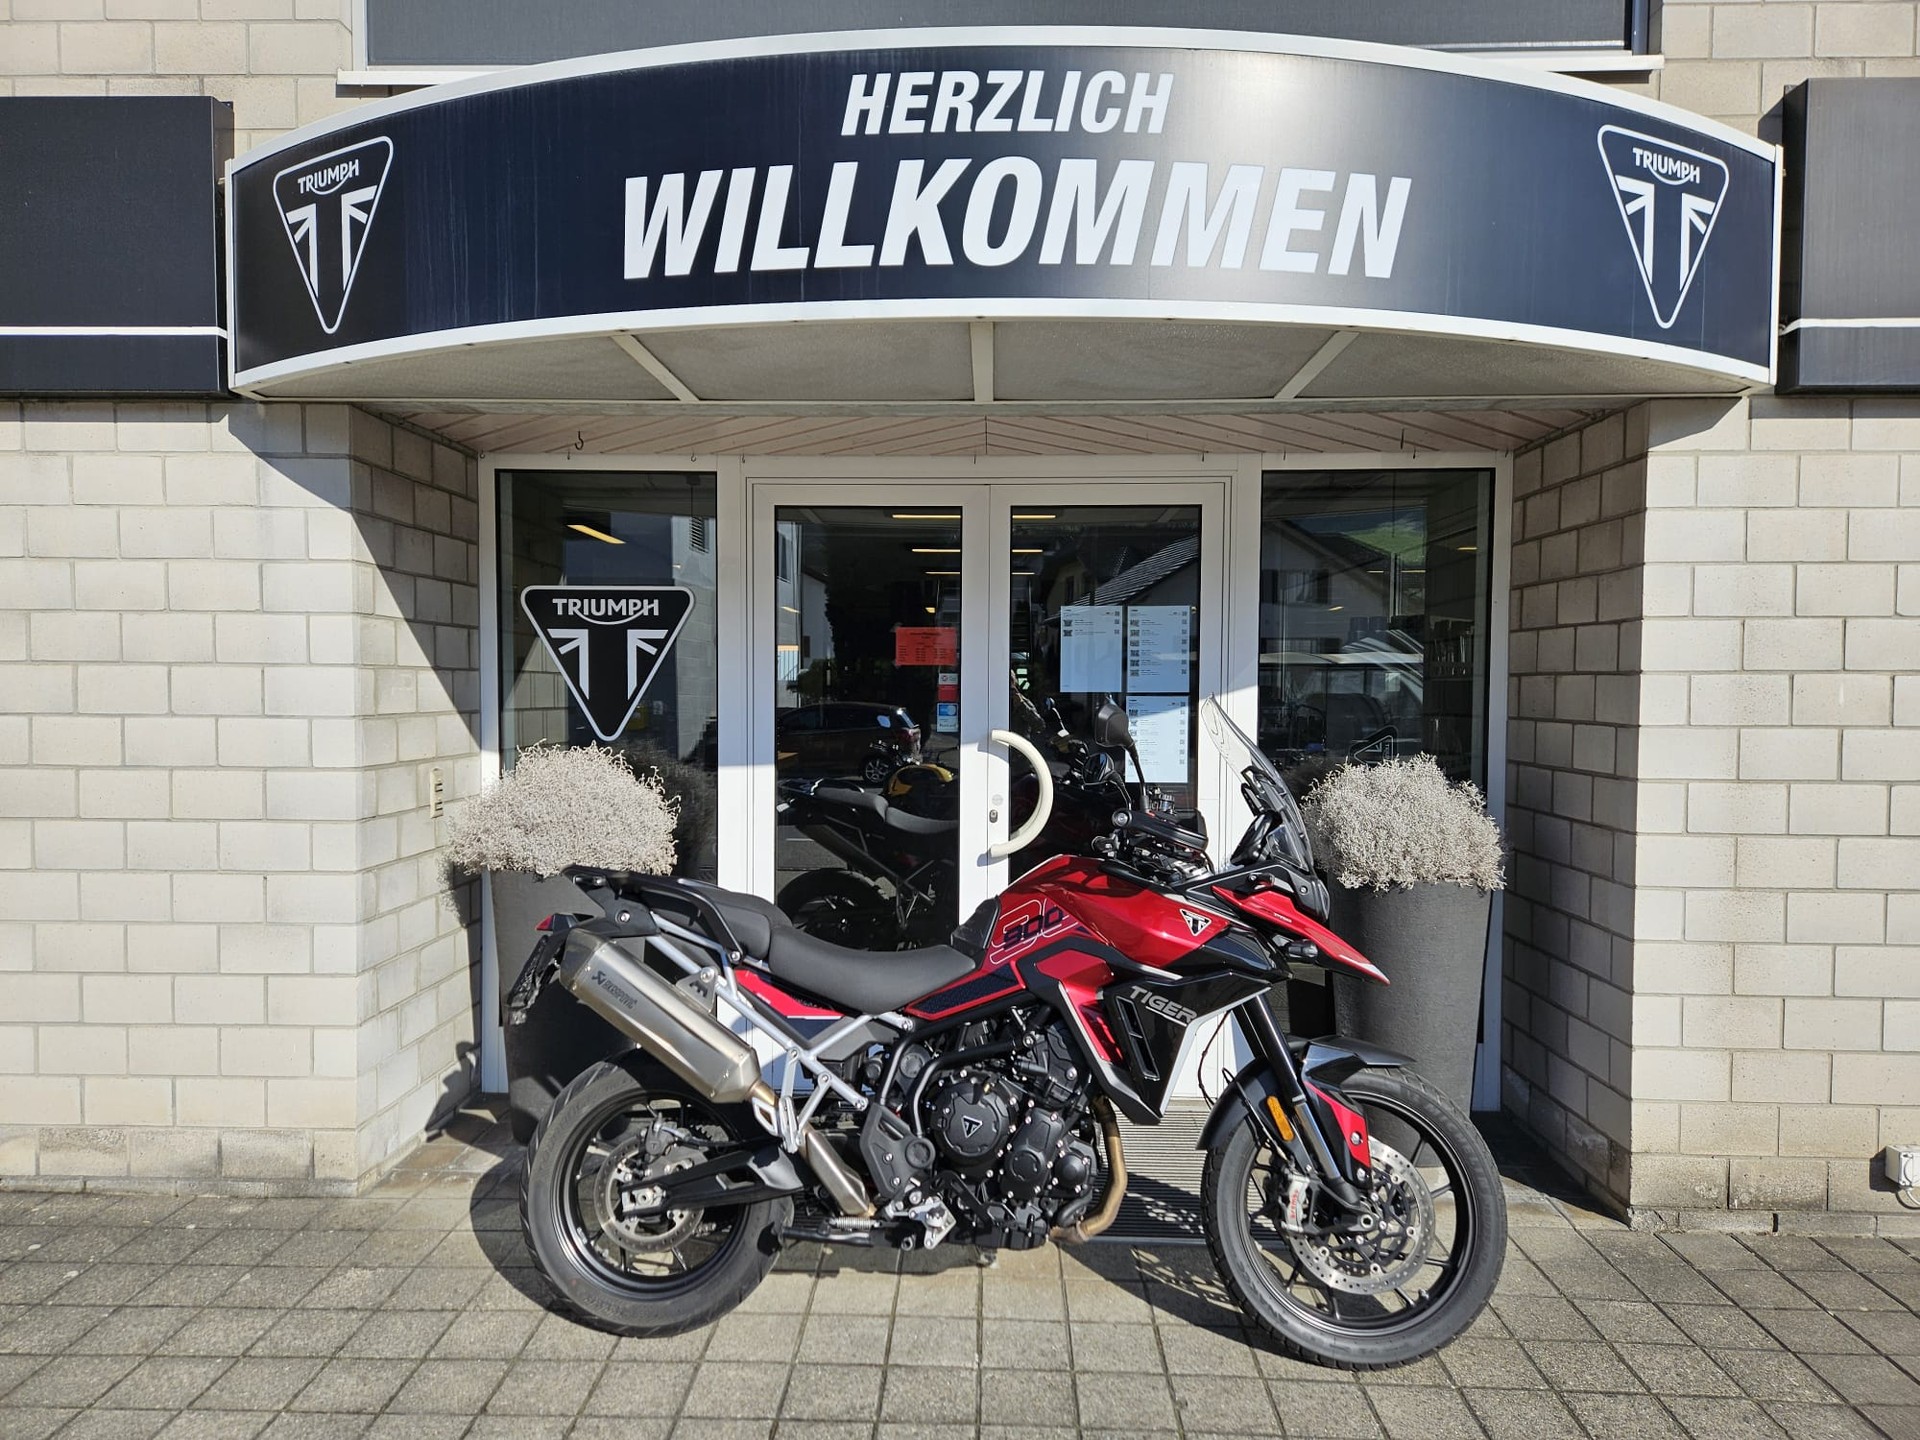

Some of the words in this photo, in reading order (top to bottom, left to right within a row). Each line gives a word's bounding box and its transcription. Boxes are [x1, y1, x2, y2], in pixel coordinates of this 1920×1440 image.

[841, 69, 1174, 136] HERZLICH
[297, 158, 360, 195] TRIUMPH
[1632, 146, 1700, 185] TRIUMPH
[623, 156, 1412, 280] WILLKOMMEN
[552, 598, 660, 625] TRIUMPH
[1130, 985, 1198, 1024] TIGER
